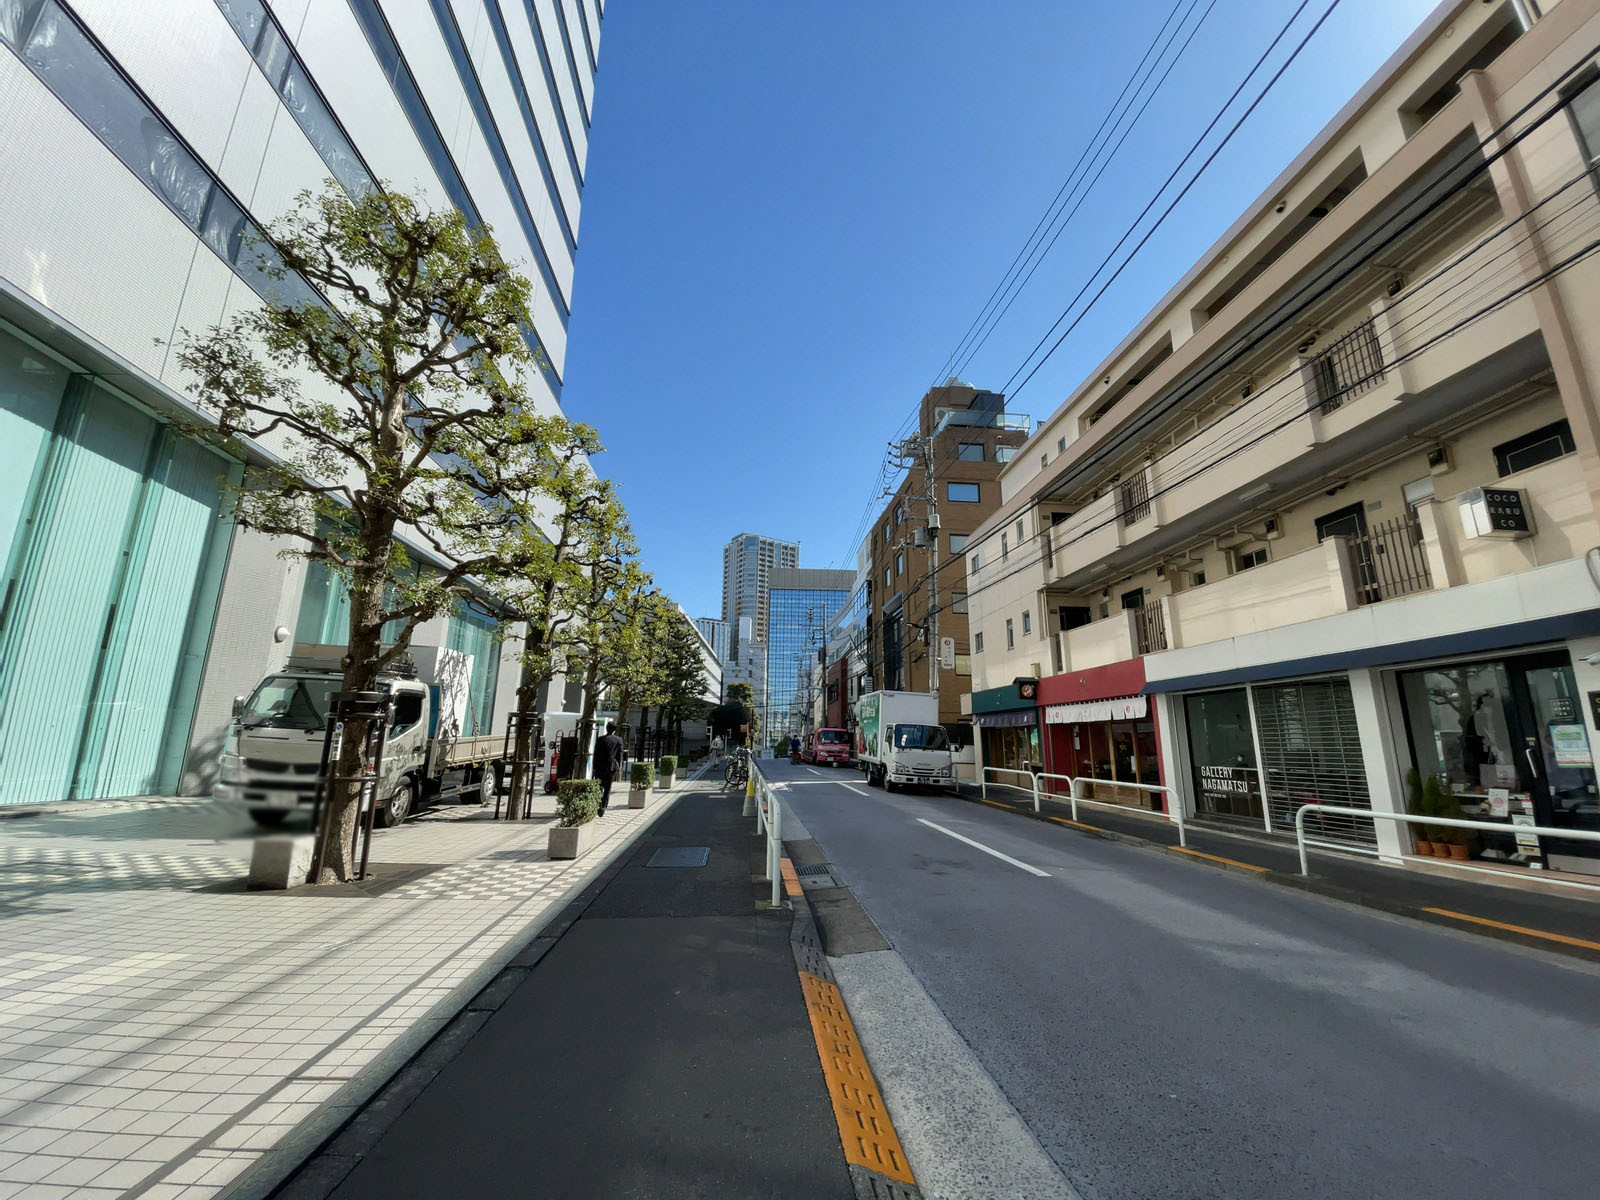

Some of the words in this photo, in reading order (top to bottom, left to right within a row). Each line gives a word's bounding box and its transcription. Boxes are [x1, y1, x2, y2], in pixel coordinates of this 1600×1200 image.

[1486, 494, 1517, 502] COCO
[1489, 507, 1520, 515] KARU
[1500, 519, 1516, 527] CO
[1201, 766, 1232, 778] GALLERY
[1202, 778, 1247, 792] NAGAMATSU
